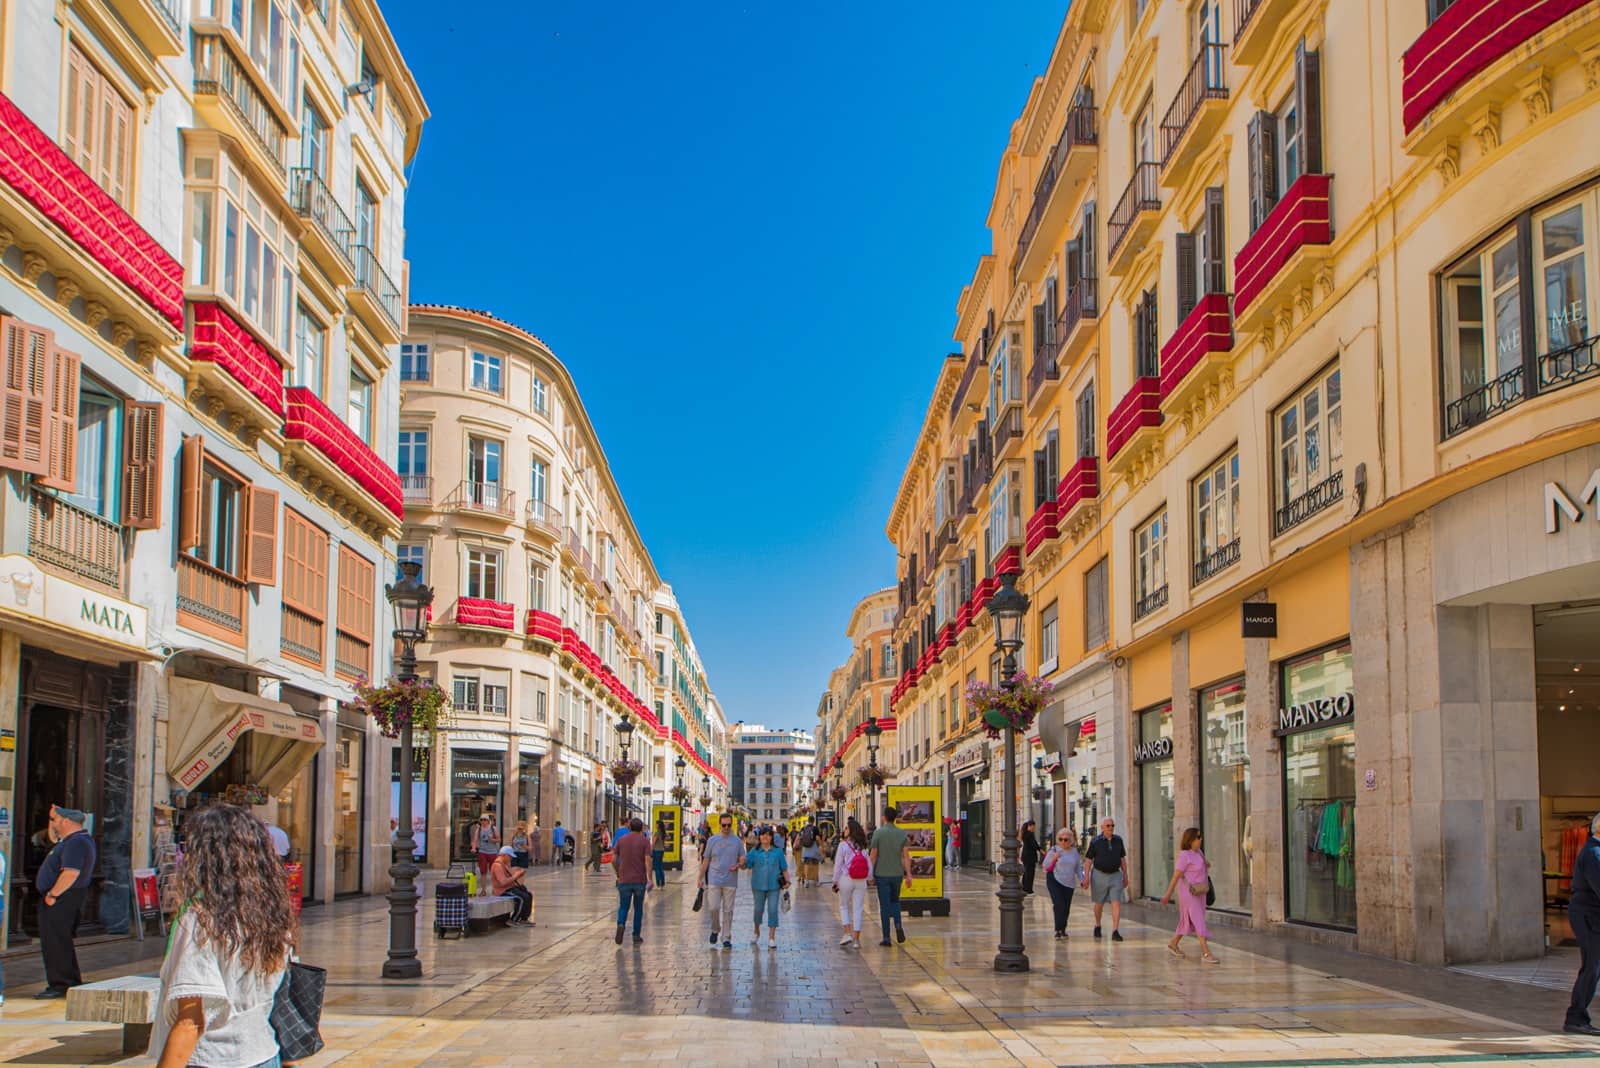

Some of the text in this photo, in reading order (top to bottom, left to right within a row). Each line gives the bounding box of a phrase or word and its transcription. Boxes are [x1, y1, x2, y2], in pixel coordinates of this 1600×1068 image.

[80, 598, 135, 636] MATA
[1245, 616, 1275, 624] MANGO
[1279, 692, 1352, 730] MANGO
[1134, 737, 1171, 761] MANGO
